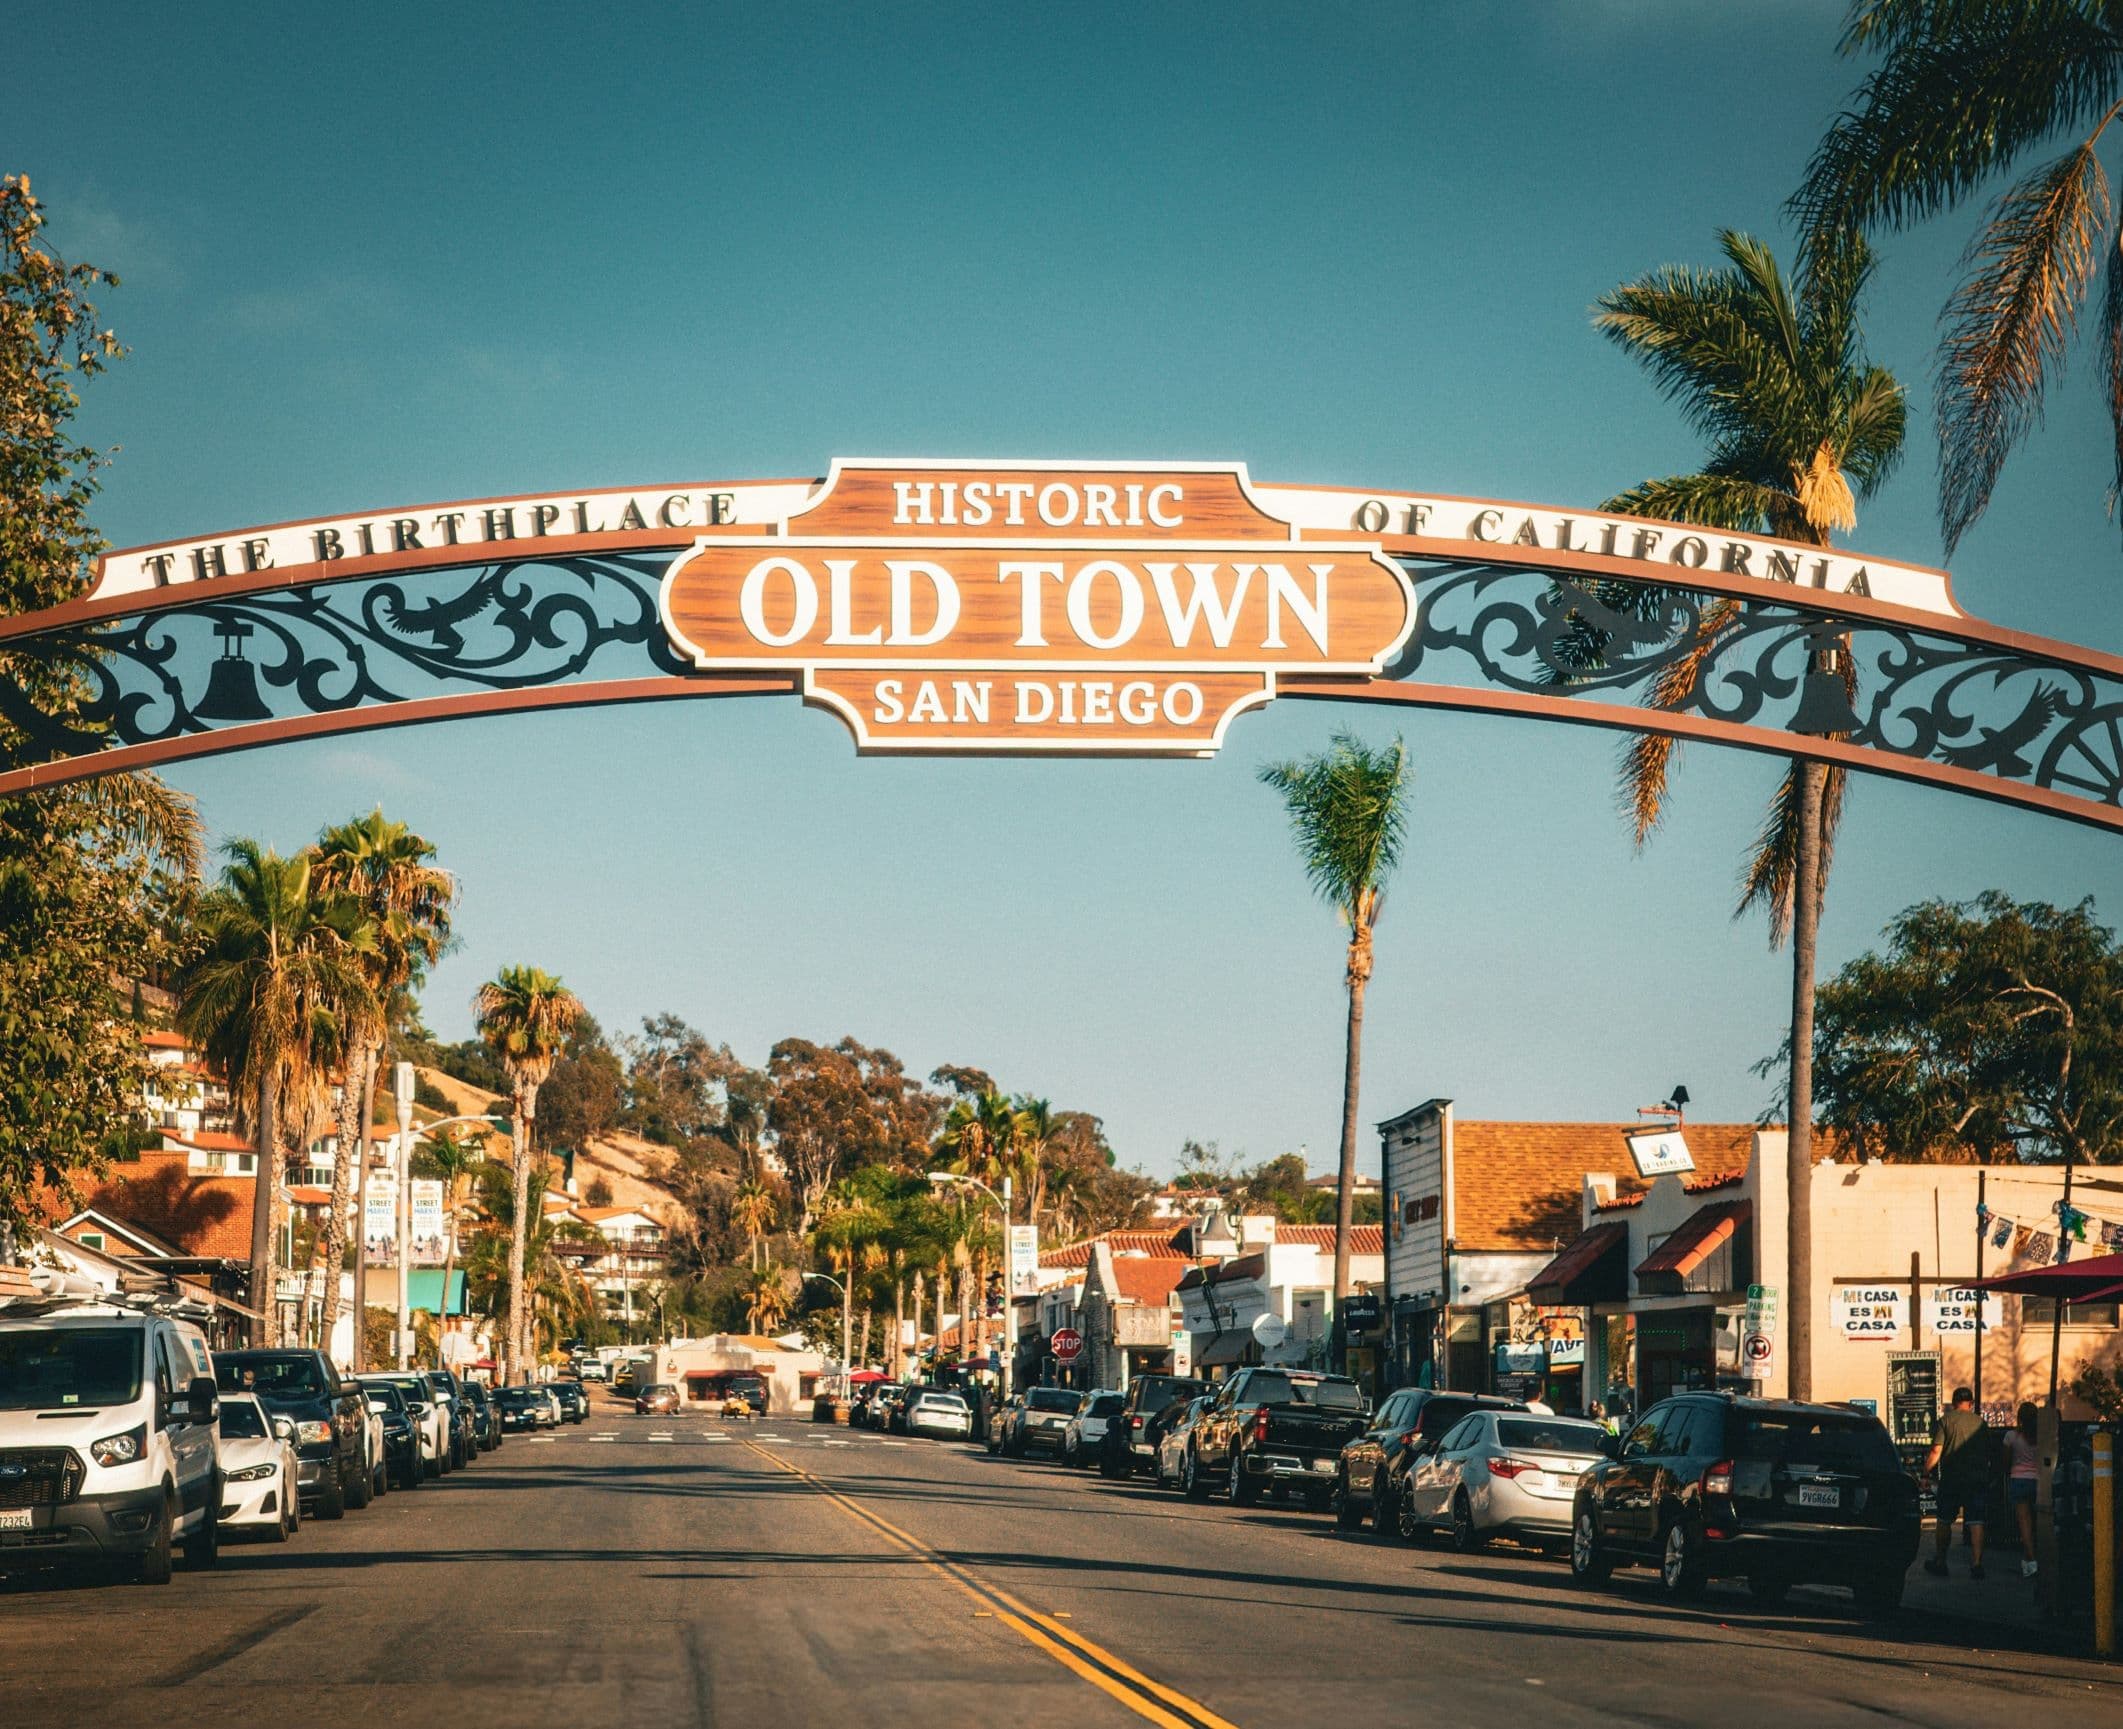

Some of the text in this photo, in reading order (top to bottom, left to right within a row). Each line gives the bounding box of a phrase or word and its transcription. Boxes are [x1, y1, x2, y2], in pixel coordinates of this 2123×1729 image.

[893, 482, 1184, 528] HISTORIC
[146, 493, 739, 587] THE BIRTHPLACE
[1356, 499, 1873, 599] OF CALIFORNIA
[740, 556, 1335, 658] OLD TOWN
[874, 679, 1205, 725] SAN DIEGO
[1843, 1290, 1899, 1303] MI CASA
[1750, 1301, 1776, 1312] PARKING
[1850, 1306, 1893, 1319] ES MI
[1940, 1307, 1962, 1316] ES
[1846, 1321, 1897, 1331] CASA
[1936, 1321, 1988, 1331] CASA
[1054, 1337, 1081, 1350] STOP
